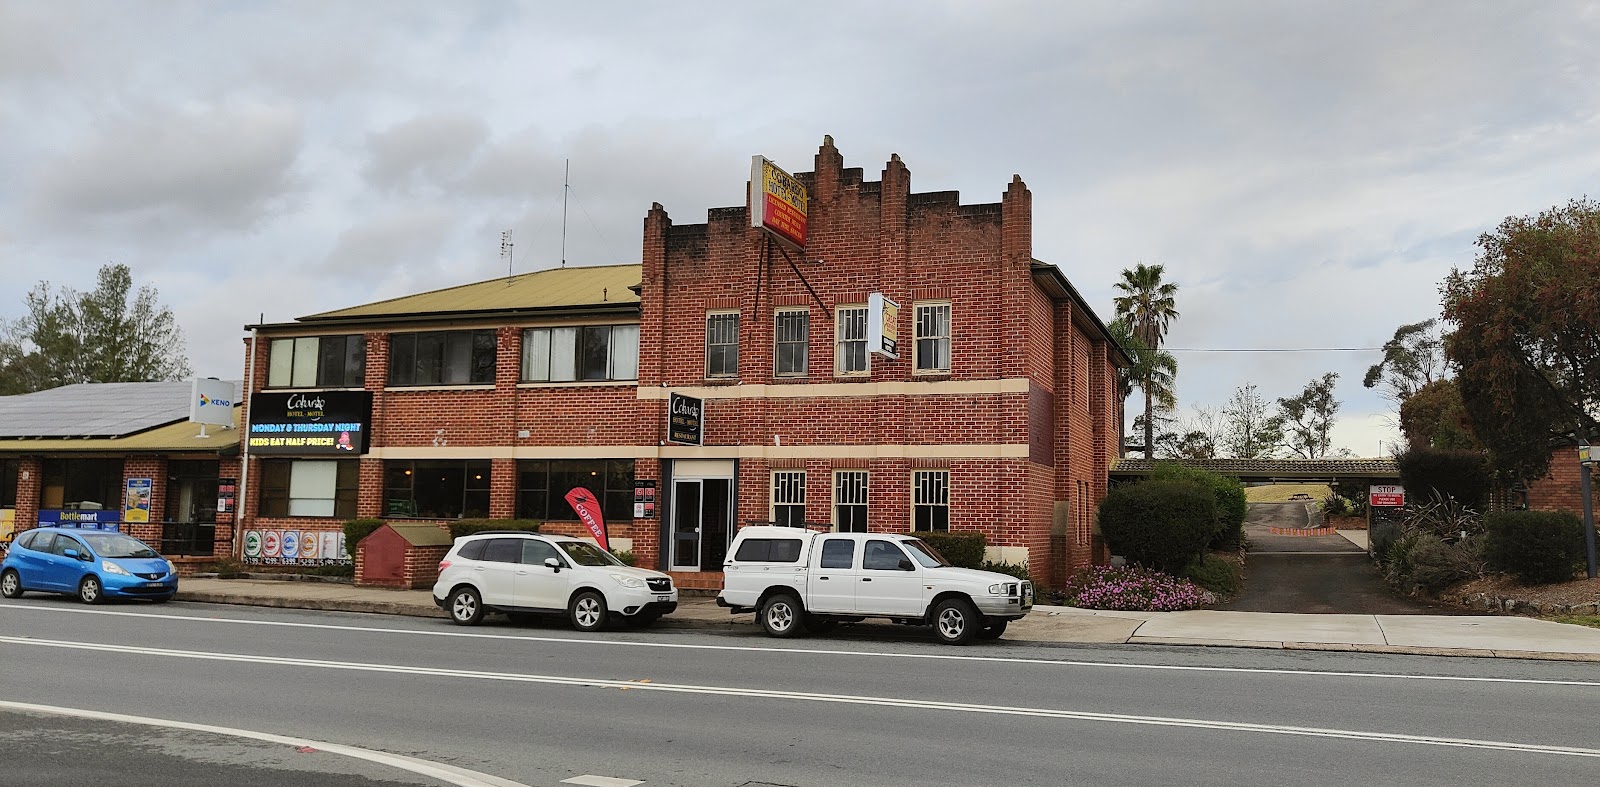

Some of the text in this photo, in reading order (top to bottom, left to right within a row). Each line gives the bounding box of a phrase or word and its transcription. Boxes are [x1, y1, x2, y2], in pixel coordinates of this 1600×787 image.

[768, 179, 787, 201] HOTEL
[771, 169, 803, 199] COBARGO
[768, 196, 787, 211] LICENSED
[774, 209, 791, 223] COUNTER
[211, 399, 230, 407] KENO
[252, 423, 361, 433] MONDAY & THURSDAY NIGHT
[249, 437, 334, 447] KIDS EAT HALF PRICE!
[674, 432, 697, 440] RESTAURANT
[60, 511, 98, 521] Bottlemart
[576, 504, 602, 537] COFFEE
